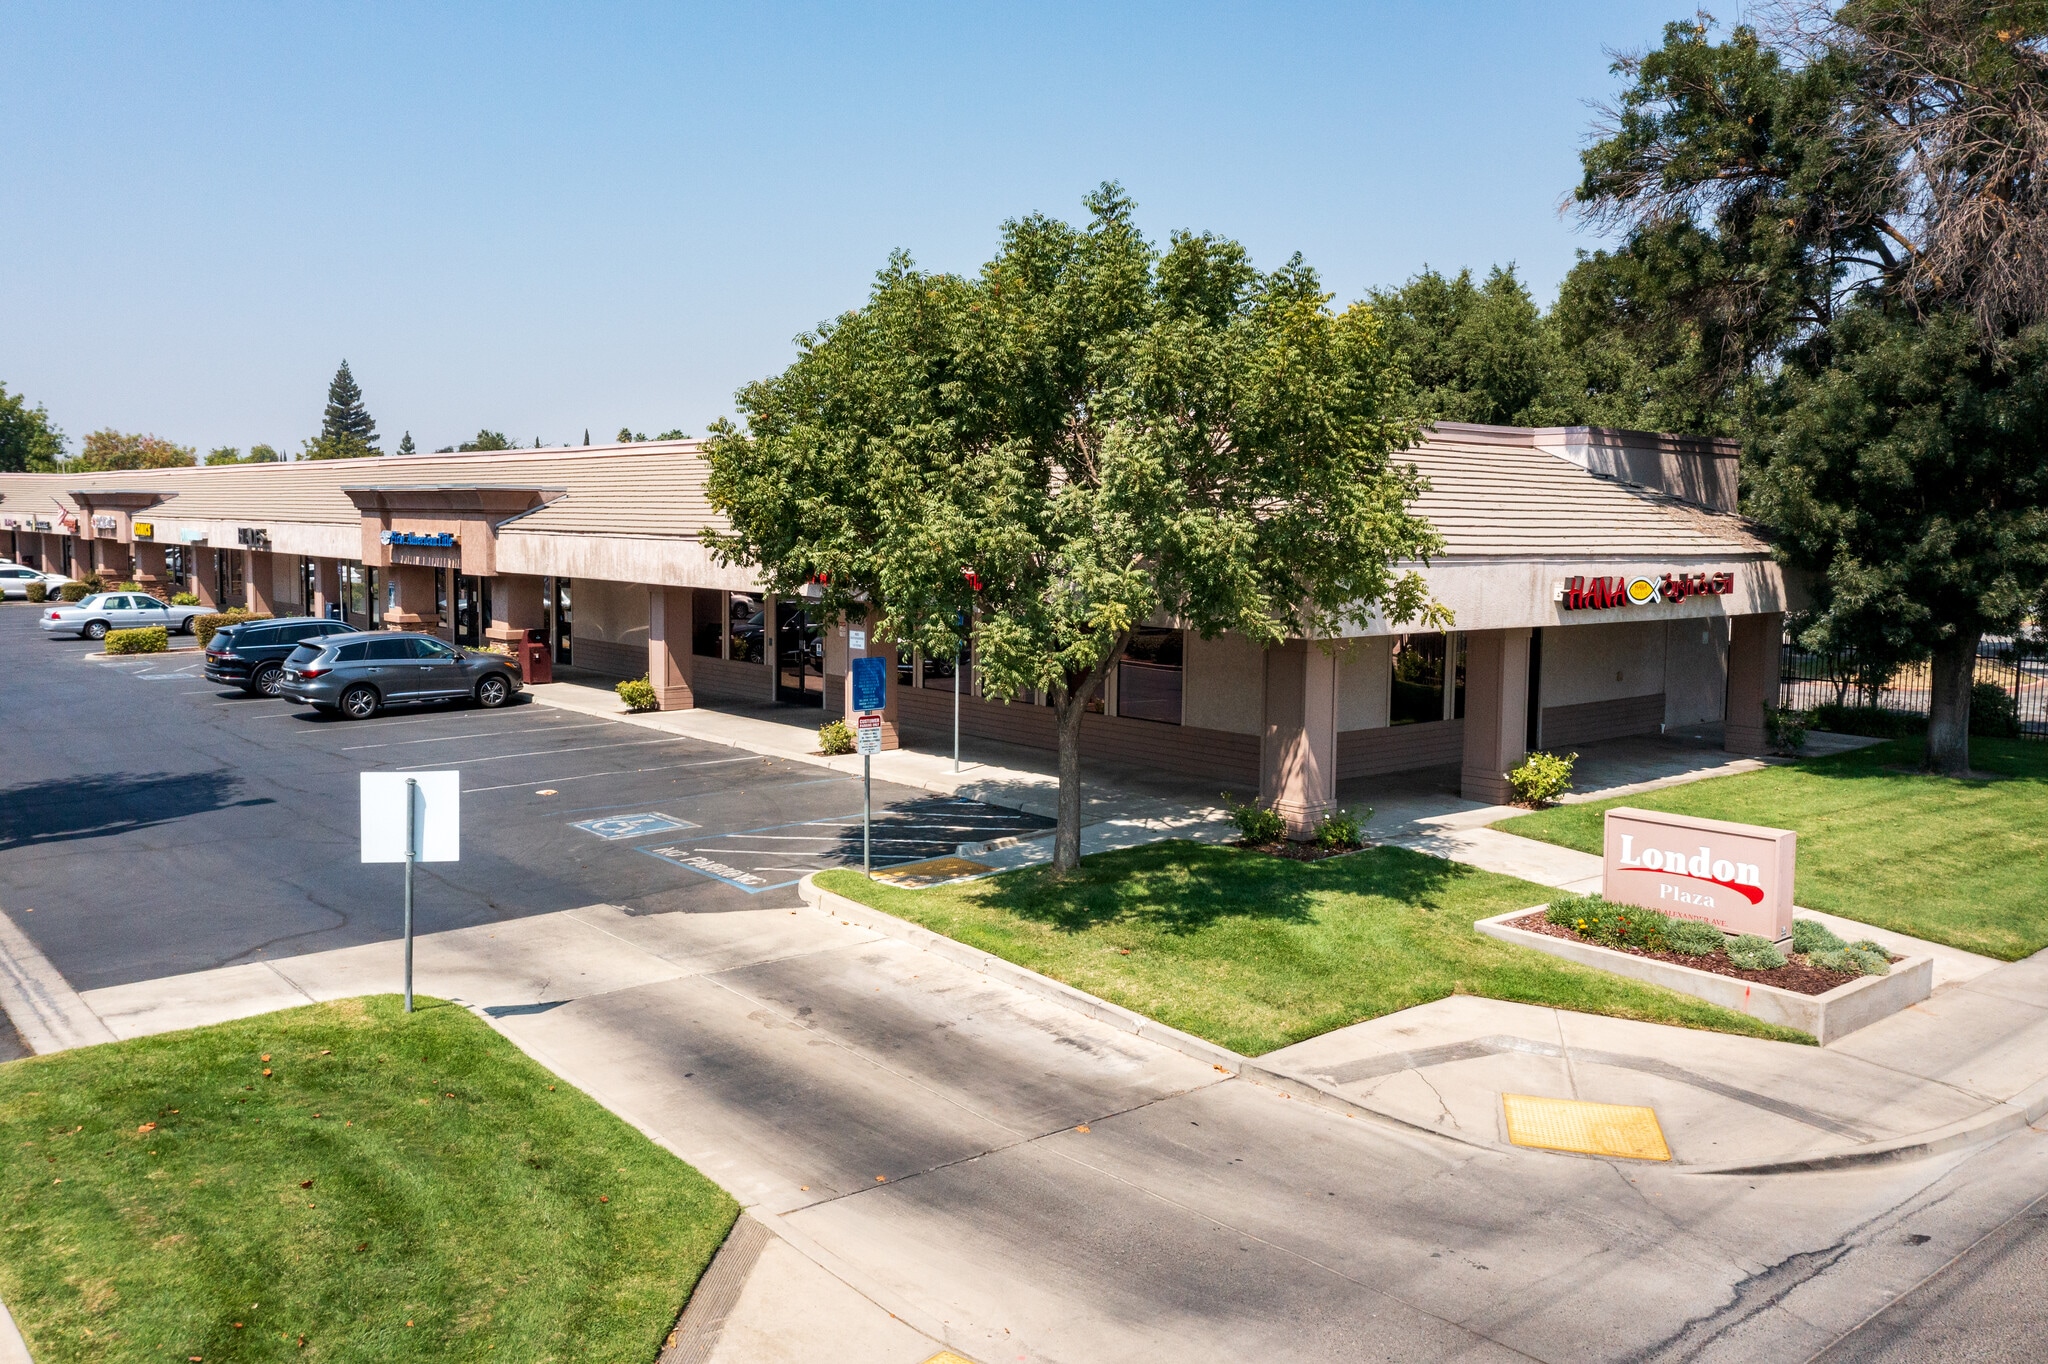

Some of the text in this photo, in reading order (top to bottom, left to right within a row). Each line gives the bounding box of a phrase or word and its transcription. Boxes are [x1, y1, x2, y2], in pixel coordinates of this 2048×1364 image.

[1567, 576, 1627, 611] HANA
[1697, 572, 1709, 596] &
[652, 846, 690, 857] NO
[1620, 834, 1761, 886] London
[680, 856, 767, 885] PARKING
[1659, 883, 1715, 908] Plaza
